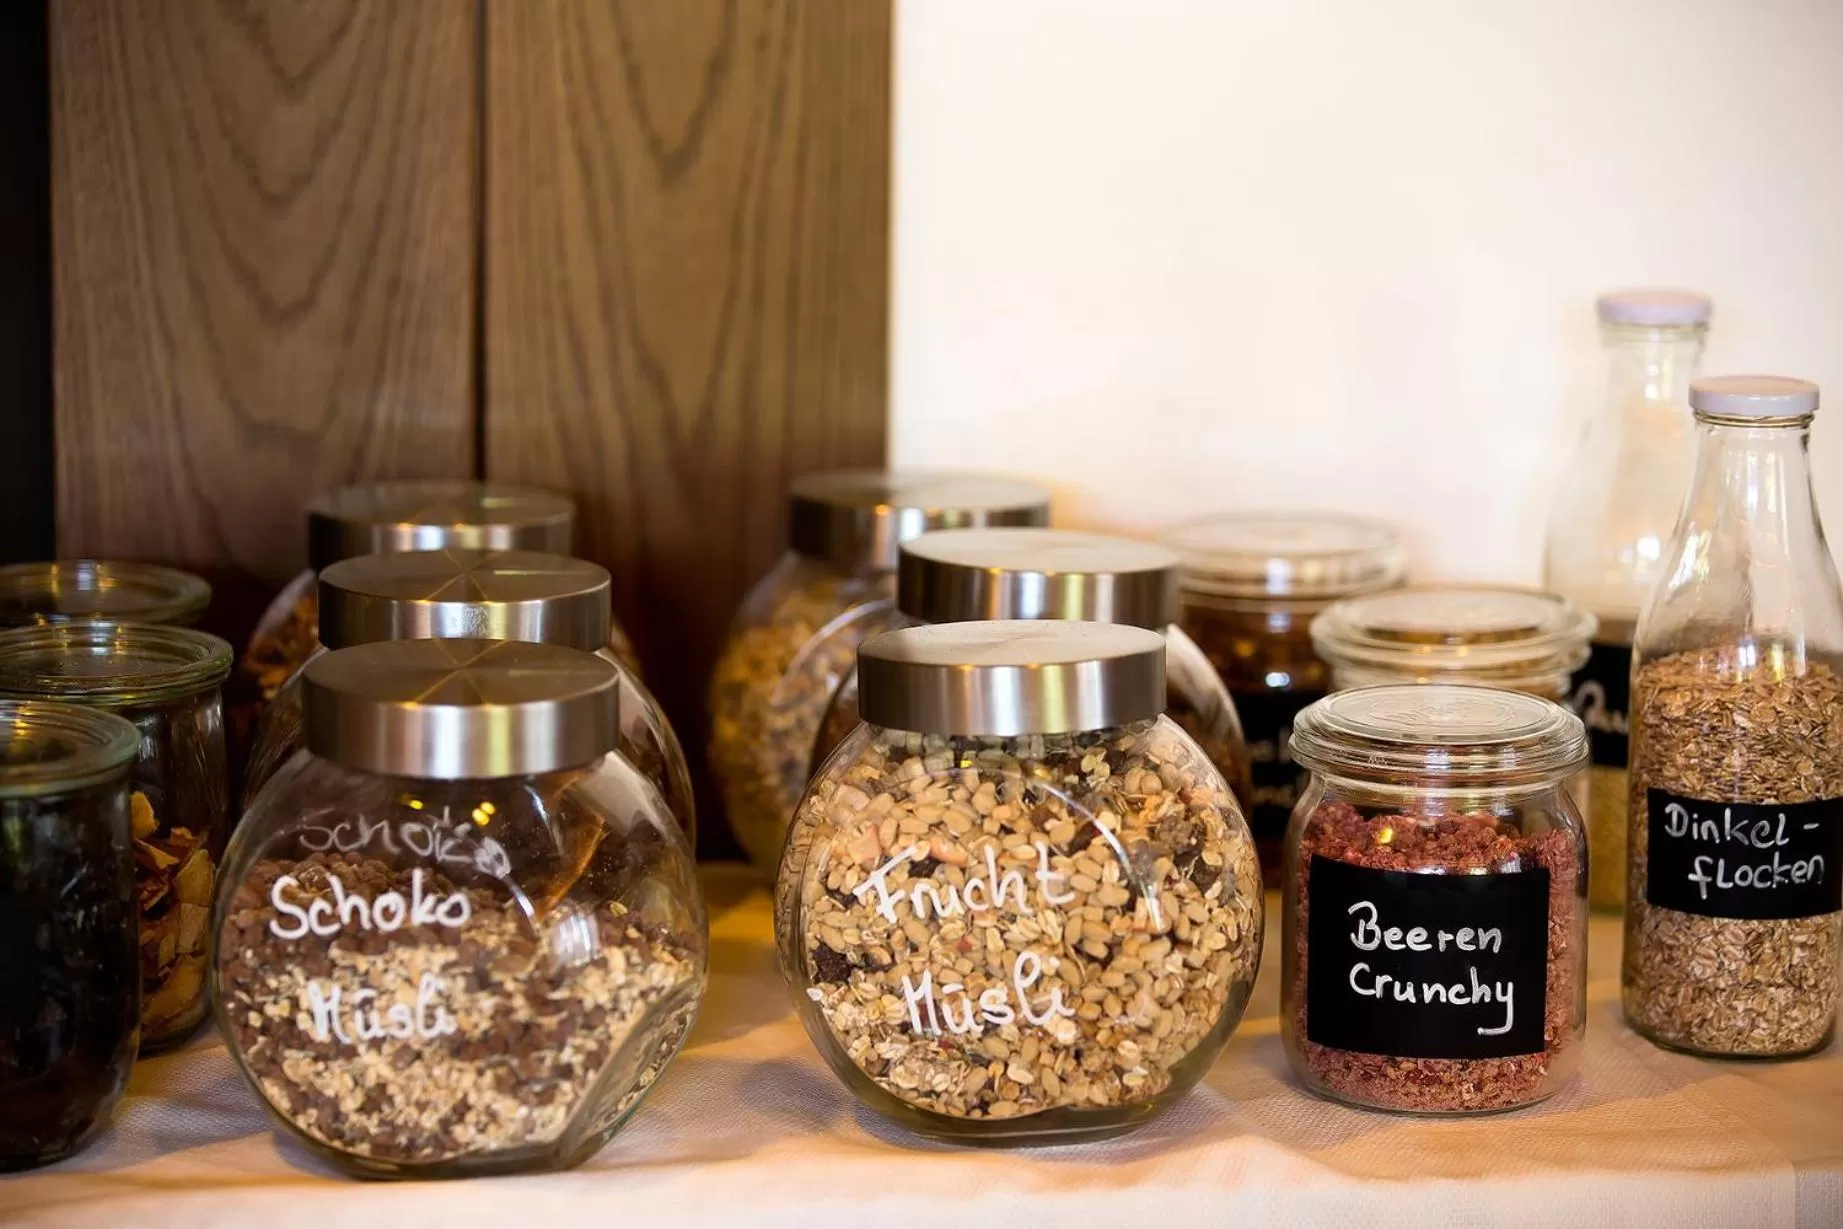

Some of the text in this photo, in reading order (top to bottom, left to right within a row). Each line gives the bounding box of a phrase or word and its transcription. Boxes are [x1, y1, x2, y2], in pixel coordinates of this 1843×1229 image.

[269, 867, 472, 940] Schoko
[852, 840, 1076, 924] Frucht
[1347, 900, 1503, 953] Beeren
[306, 971, 457, 1045] Müsli
[901, 951, 1076, 1036] Müsli
[1349, 961, 1514, 1036] Crunchy
